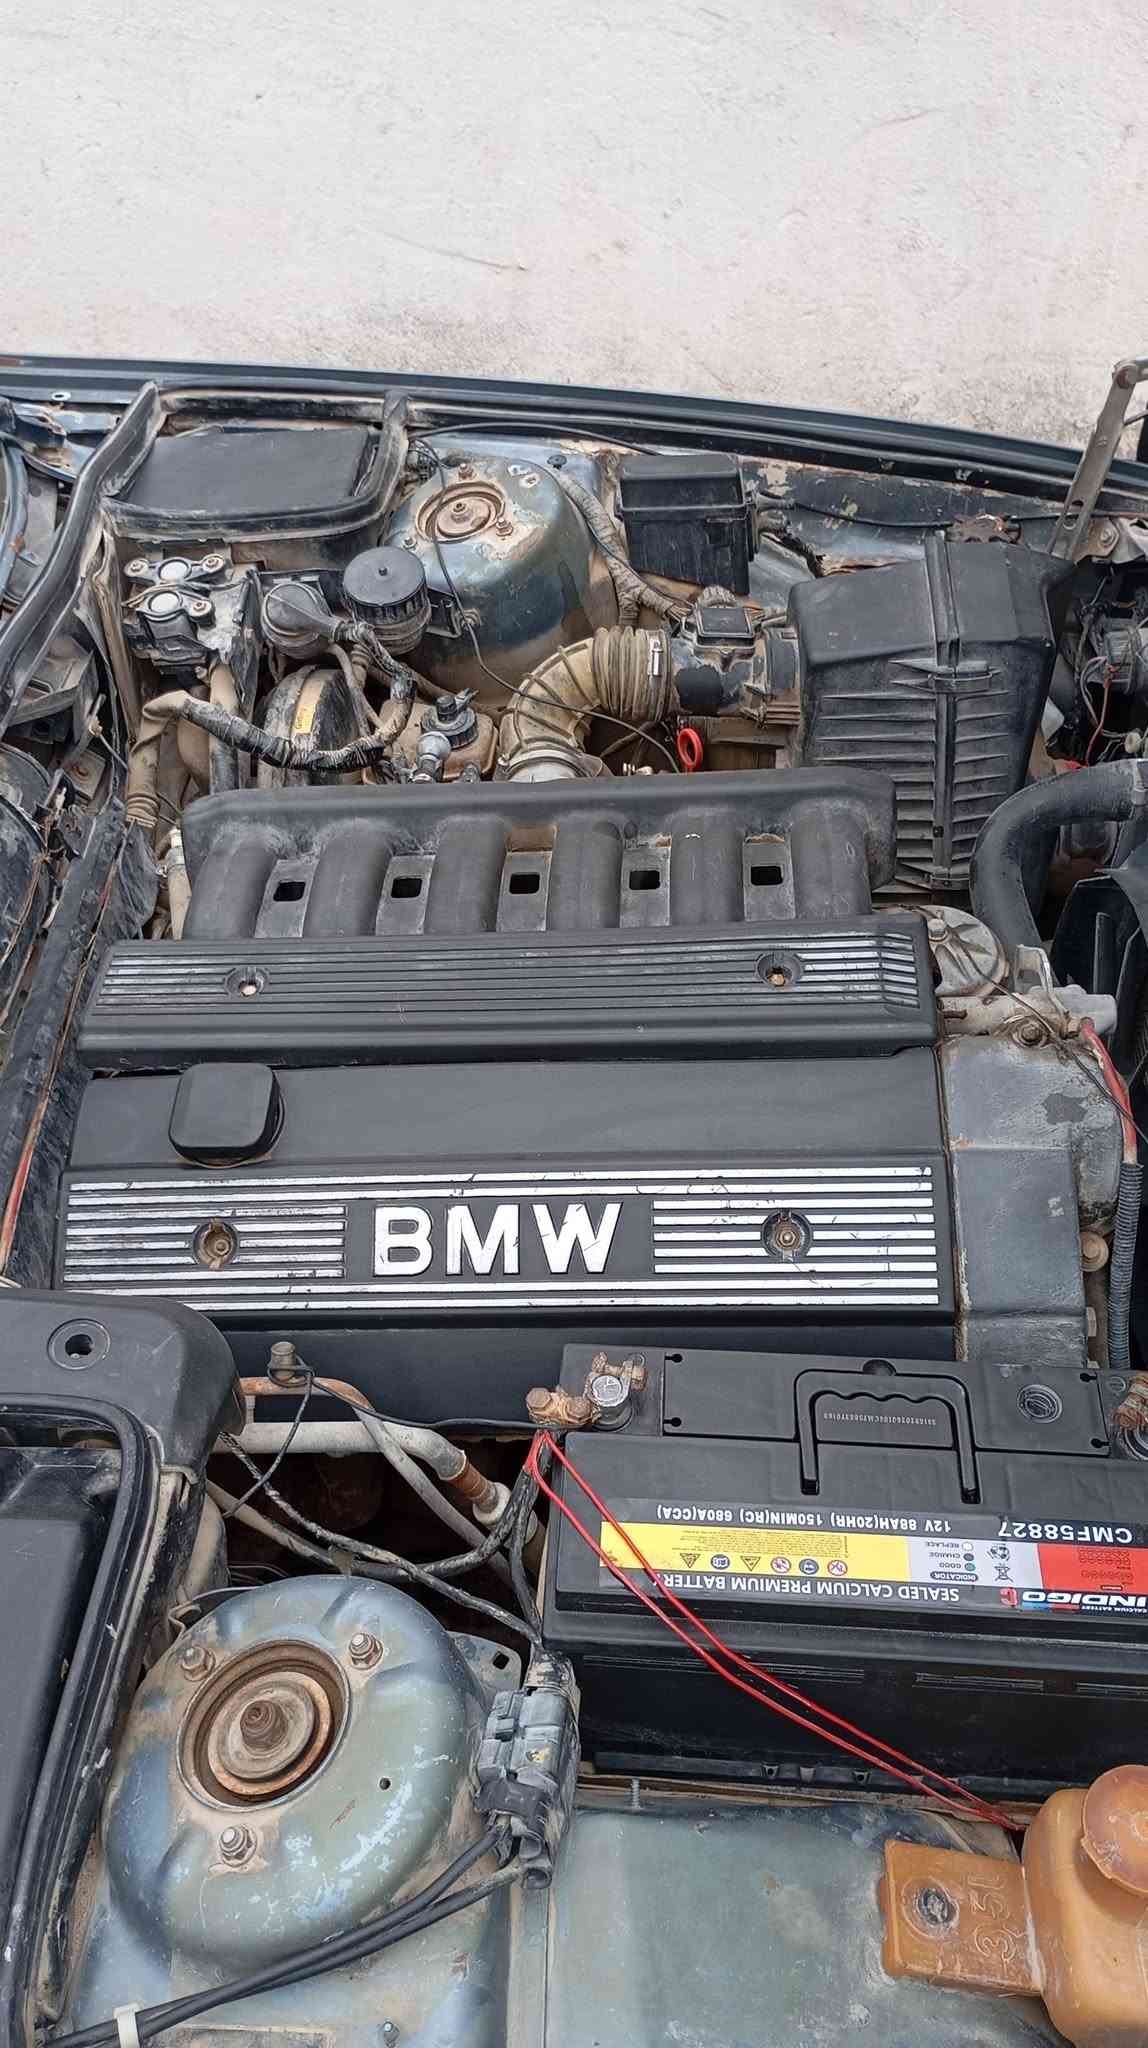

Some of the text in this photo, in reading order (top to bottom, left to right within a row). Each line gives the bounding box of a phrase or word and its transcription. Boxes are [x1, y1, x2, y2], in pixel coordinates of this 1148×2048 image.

[374, 1202, 624, 1276] BMW
[656, 1504, 951, 1533] 12V 88AH(20HR) 150MIN(RC) 680A(CCA)
[998, 1521, 1133, 1544] CMF58827
[731, 1577, 811, 1595] PREMIUM
[817, 1581, 893, 1598] CALCIUM
[898, 1586, 960, 1602] SEALED
[1022, 1591, 1147, 1607] INDIGO
